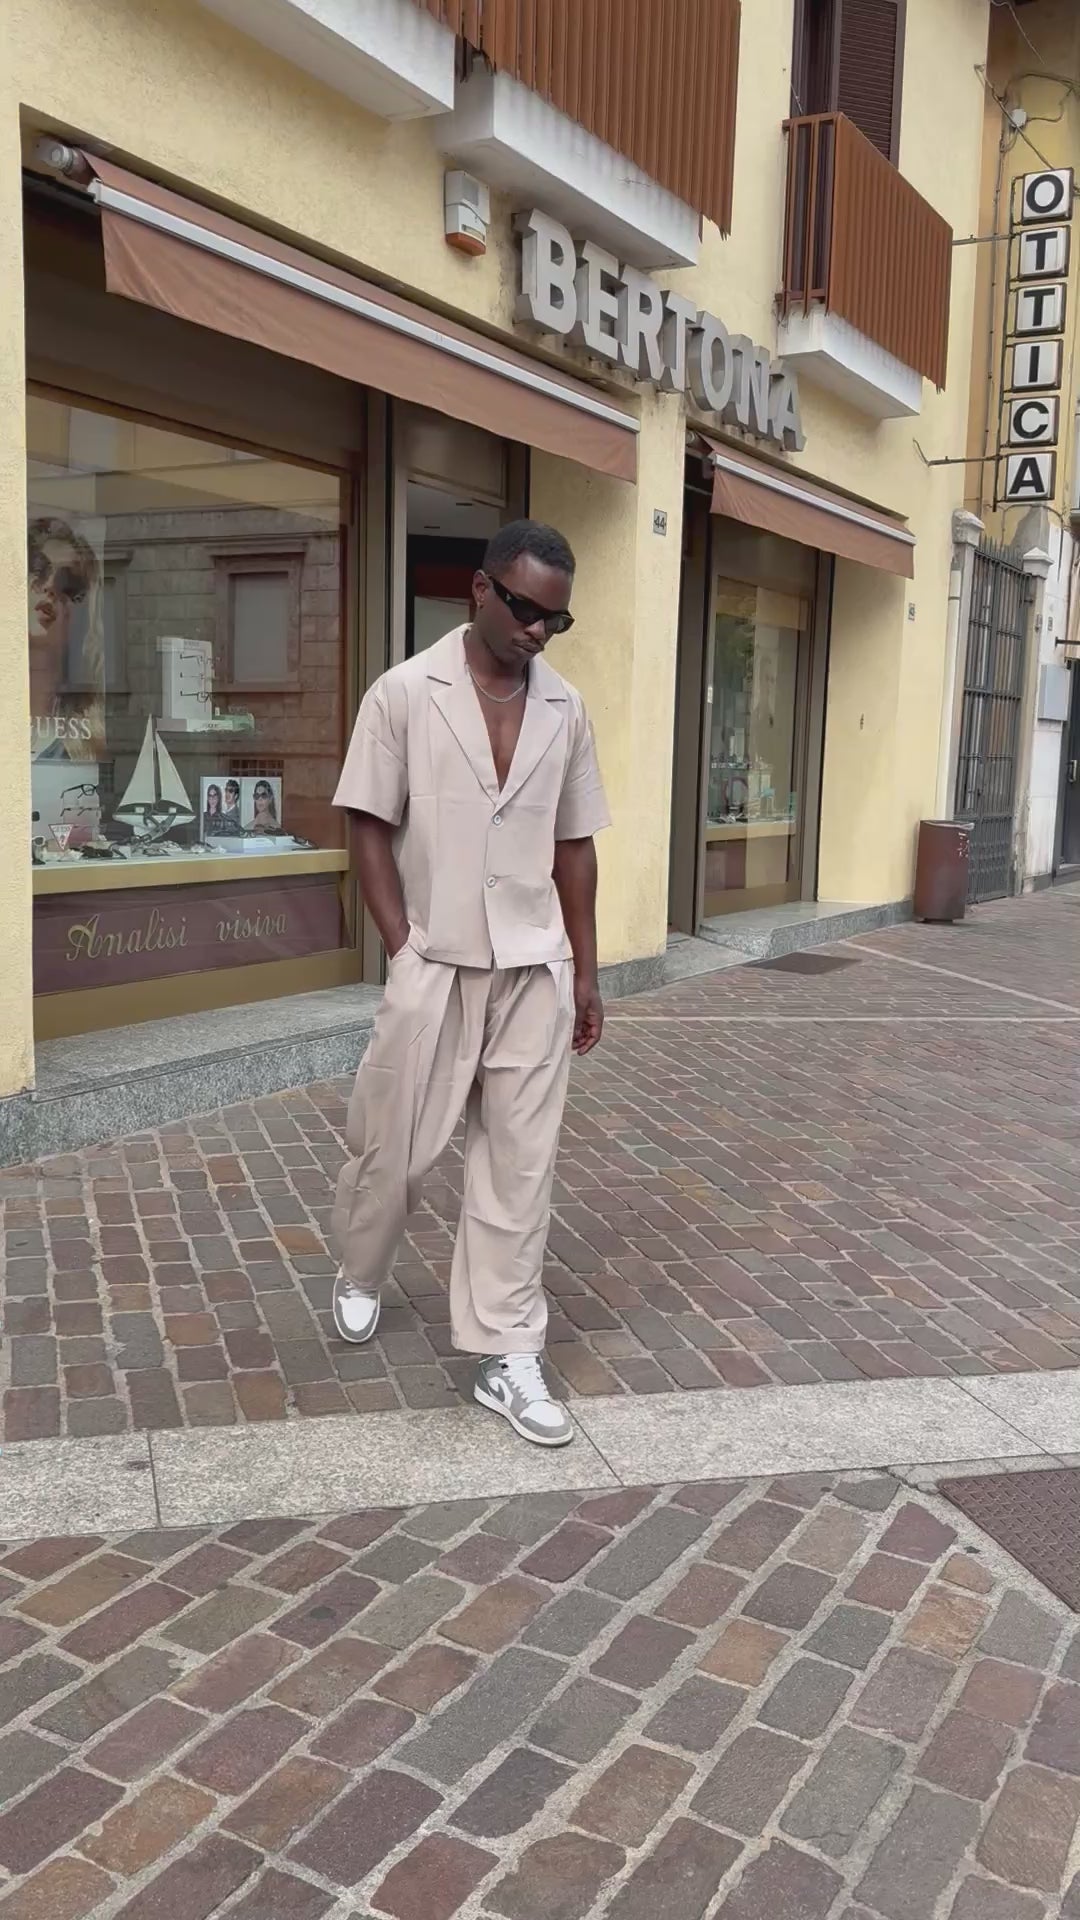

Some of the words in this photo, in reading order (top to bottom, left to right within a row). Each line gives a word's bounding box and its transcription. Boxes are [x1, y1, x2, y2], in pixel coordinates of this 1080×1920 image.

[518, 208, 806, 451] BERTONA
[1009, 174, 1064, 495] OTTICA
[31, 716, 92, 740] UESS
[66, 908, 189, 961] Analisi
[216, 909, 288, 941] visiva
